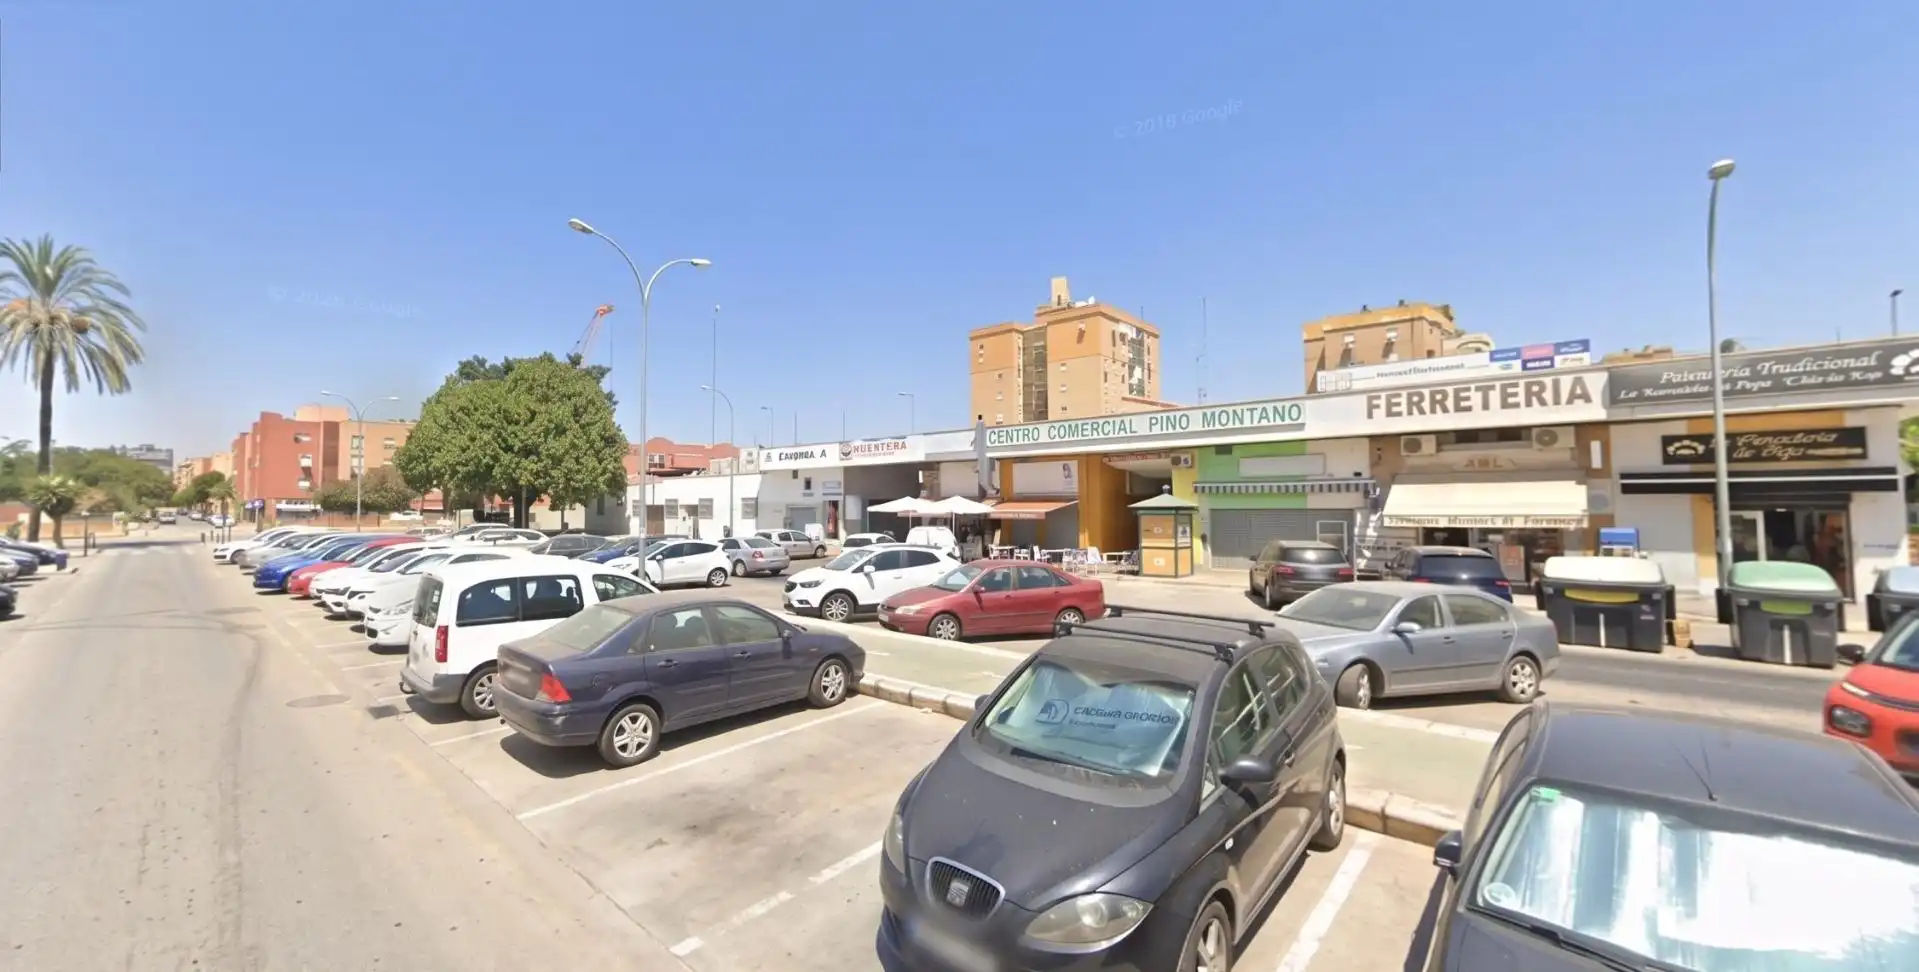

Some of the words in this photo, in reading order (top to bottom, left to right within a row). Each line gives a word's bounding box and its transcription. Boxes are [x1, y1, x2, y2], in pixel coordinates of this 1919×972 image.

[1366, 376, 1593, 420] FERRETERIA
[988, 429, 1041, 445] CENTRO
[1047, 419, 1138, 440] COMERCIAL
[1149, 413, 1191, 432] PINO
[1201, 403, 1302, 428] MONTANO
